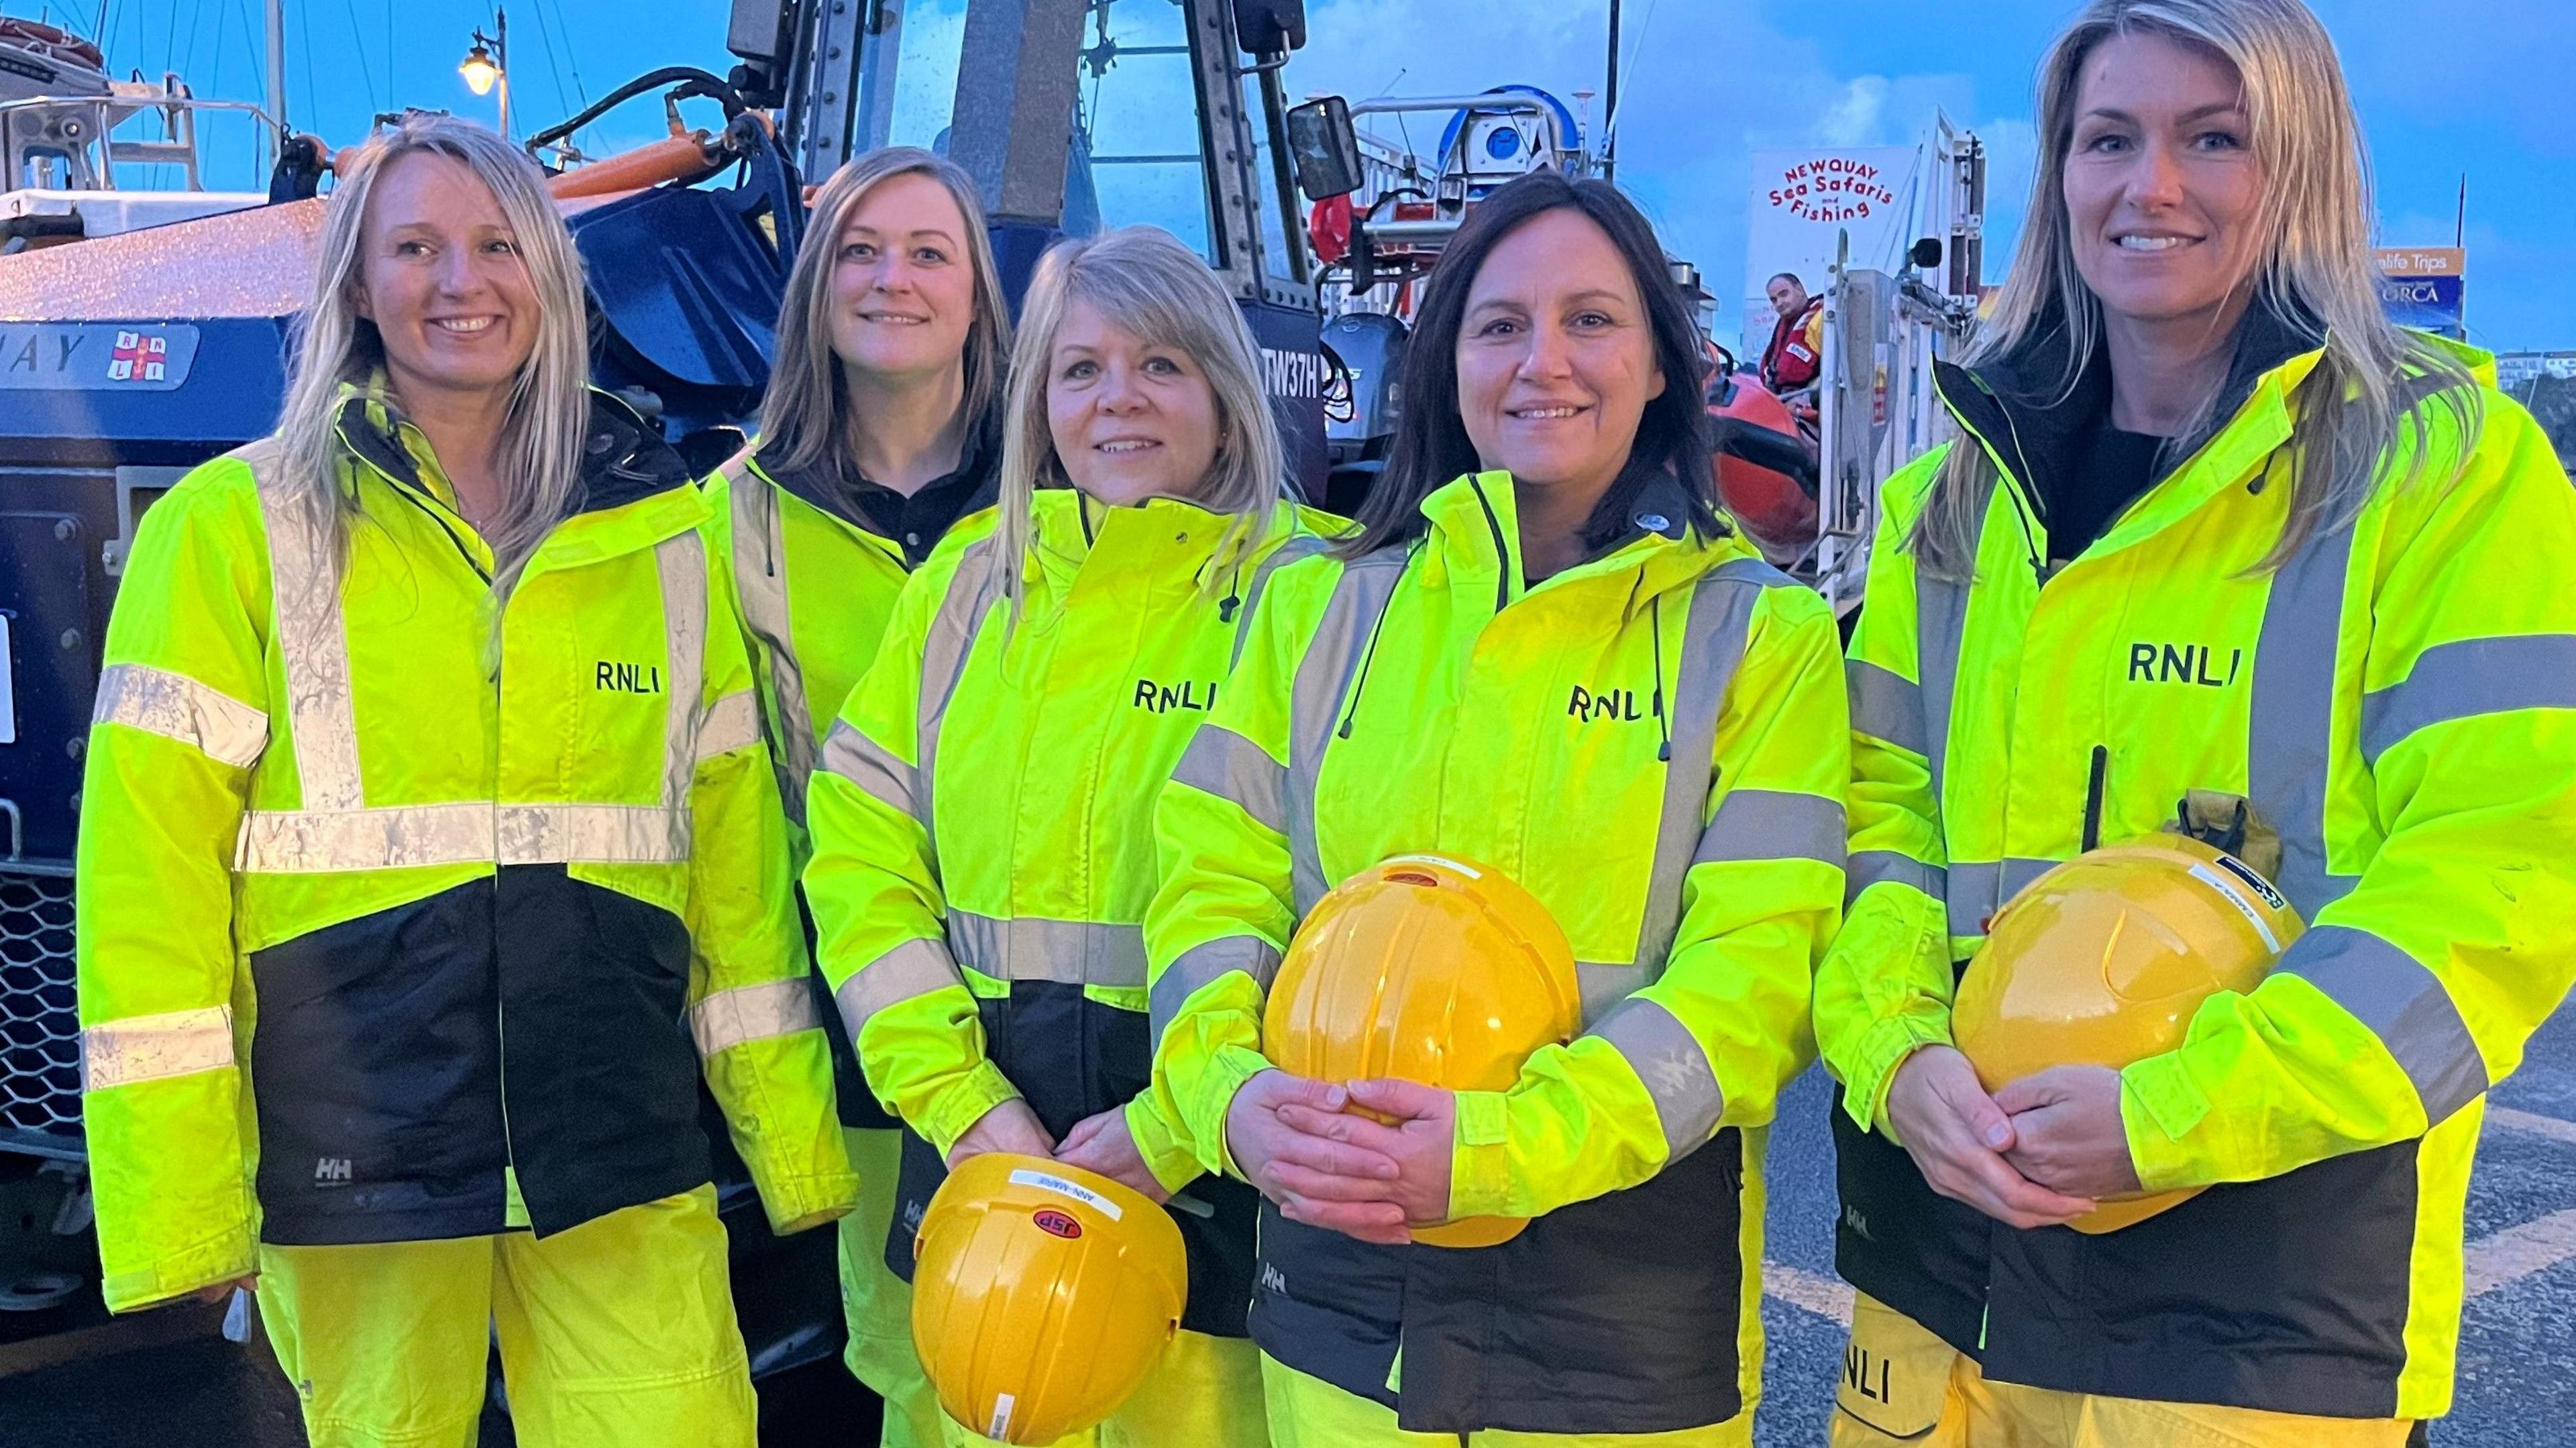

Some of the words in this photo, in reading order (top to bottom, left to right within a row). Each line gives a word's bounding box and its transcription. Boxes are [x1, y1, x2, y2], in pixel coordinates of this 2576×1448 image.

[1784, 158, 1878, 184] NEWQUAY
[1769, 183, 1808, 207] Sea
[1815, 176, 1893, 205] Safaris
[1790, 199, 1870, 222] Fishing
[2411, 253, 2447, 274] Trips
[2382, 286, 2439, 302] ORCA
[0, 334, 85, 372] AY
[596, 661, 660, 693] RNLI
[2129, 643, 2241, 687] RNLI
[1134, 679, 1217, 714] RNLI
[1568, 685, 1662, 723] RNLI
[316, 1158, 352, 1179] HH
[1040, 1215, 1076, 1235] JSP
[1261, 1262, 1287, 1294] HH
[1841, 1343, 1890, 1404] NLI
